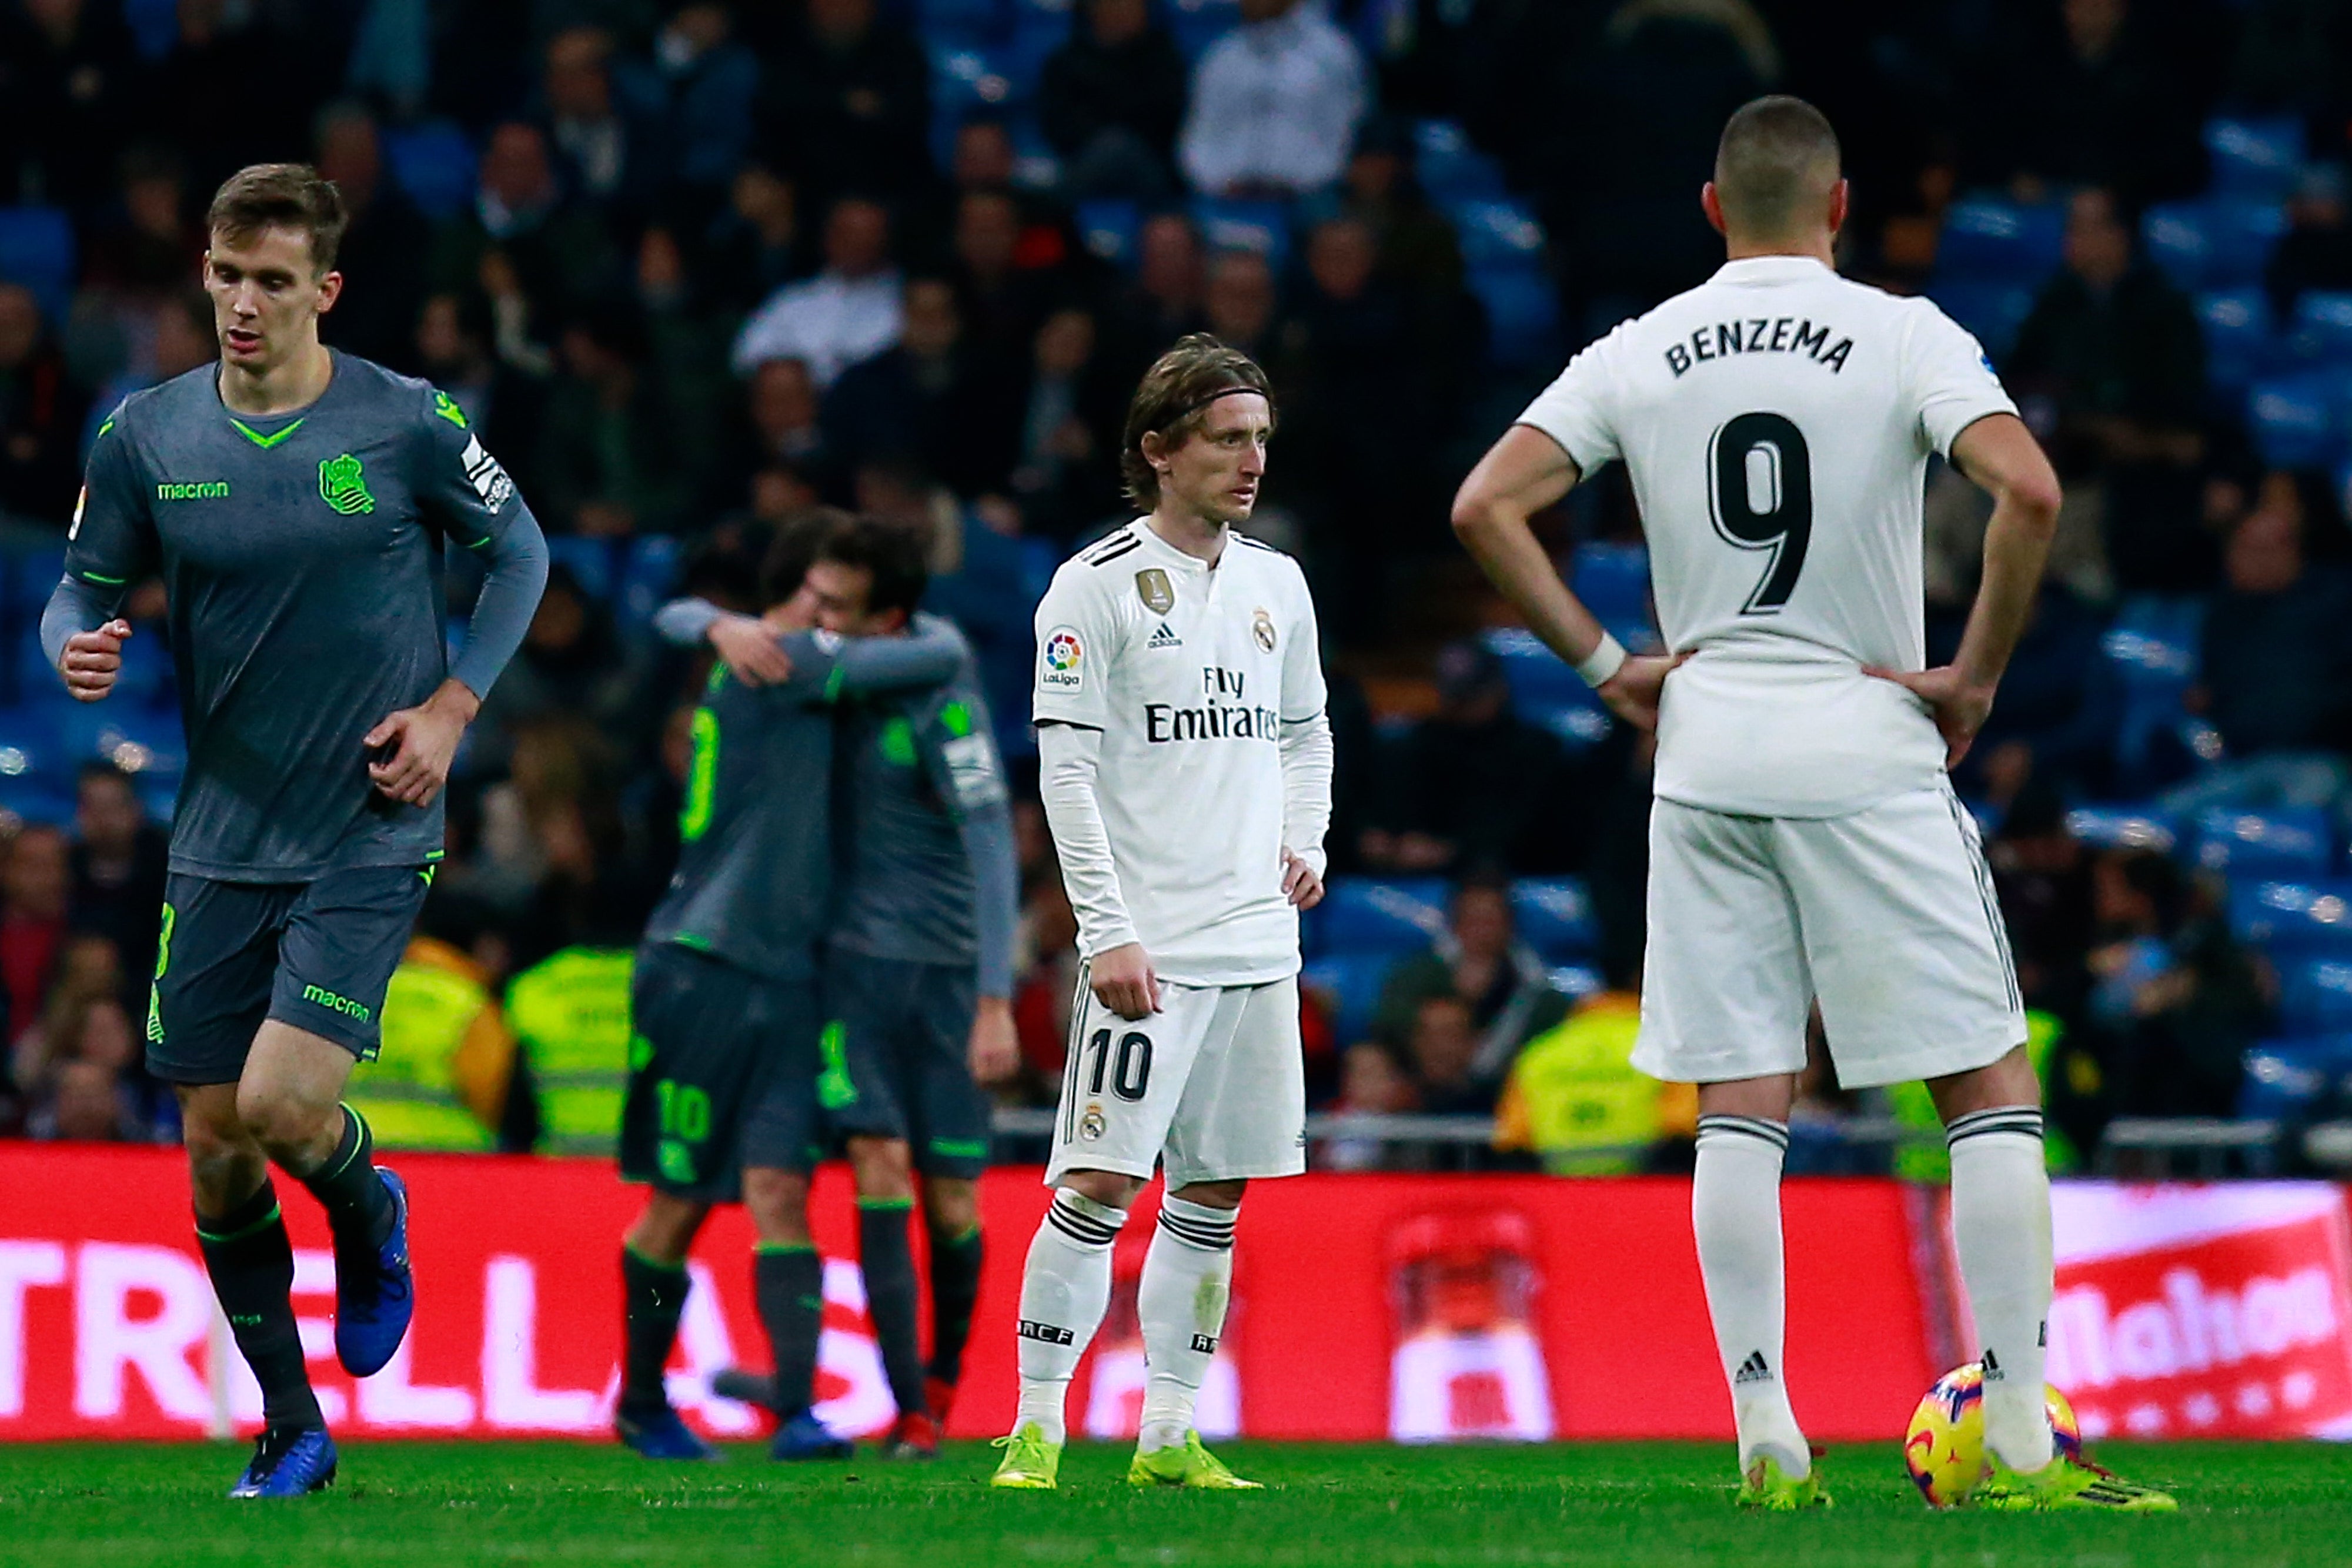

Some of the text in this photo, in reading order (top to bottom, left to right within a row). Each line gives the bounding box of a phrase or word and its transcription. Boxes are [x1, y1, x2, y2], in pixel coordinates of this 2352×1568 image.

[1665, 318, 1853, 377] BENZEMA
[158, 482, 228, 500] macron
[1707, 412, 1812, 616] 9
[1043, 673, 1080, 686] LaLiga
[1204, 667, 1244, 698] Fly
[1144, 698, 1278, 743] Emirates
[303, 984, 370, 1024] macron
[1087, 1028, 1152, 1102] 10
[657, 1078, 710, 1142] 10
